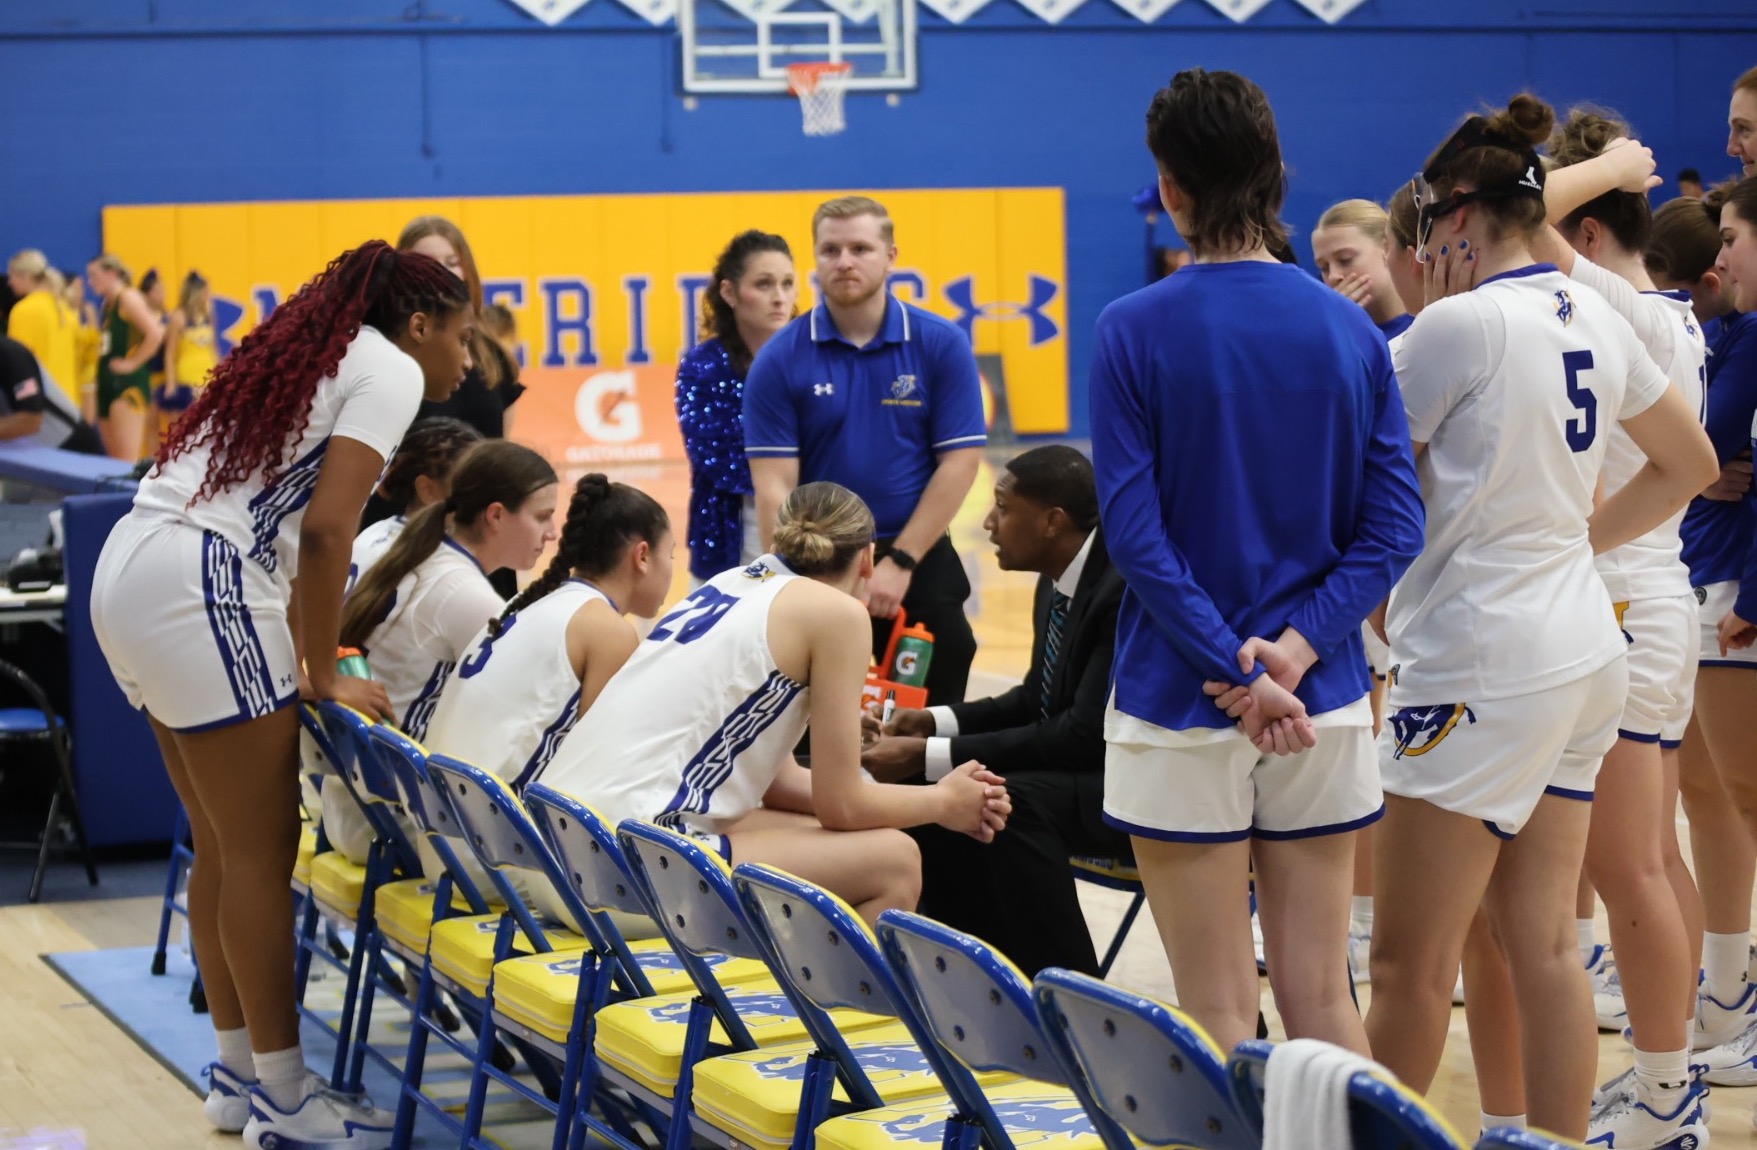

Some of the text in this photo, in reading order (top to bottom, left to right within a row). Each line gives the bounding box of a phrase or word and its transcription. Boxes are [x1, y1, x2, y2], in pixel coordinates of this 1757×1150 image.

[575, 370, 643, 442] G
[1562, 350, 1597, 453] 5
[896, 650, 918, 676] G
